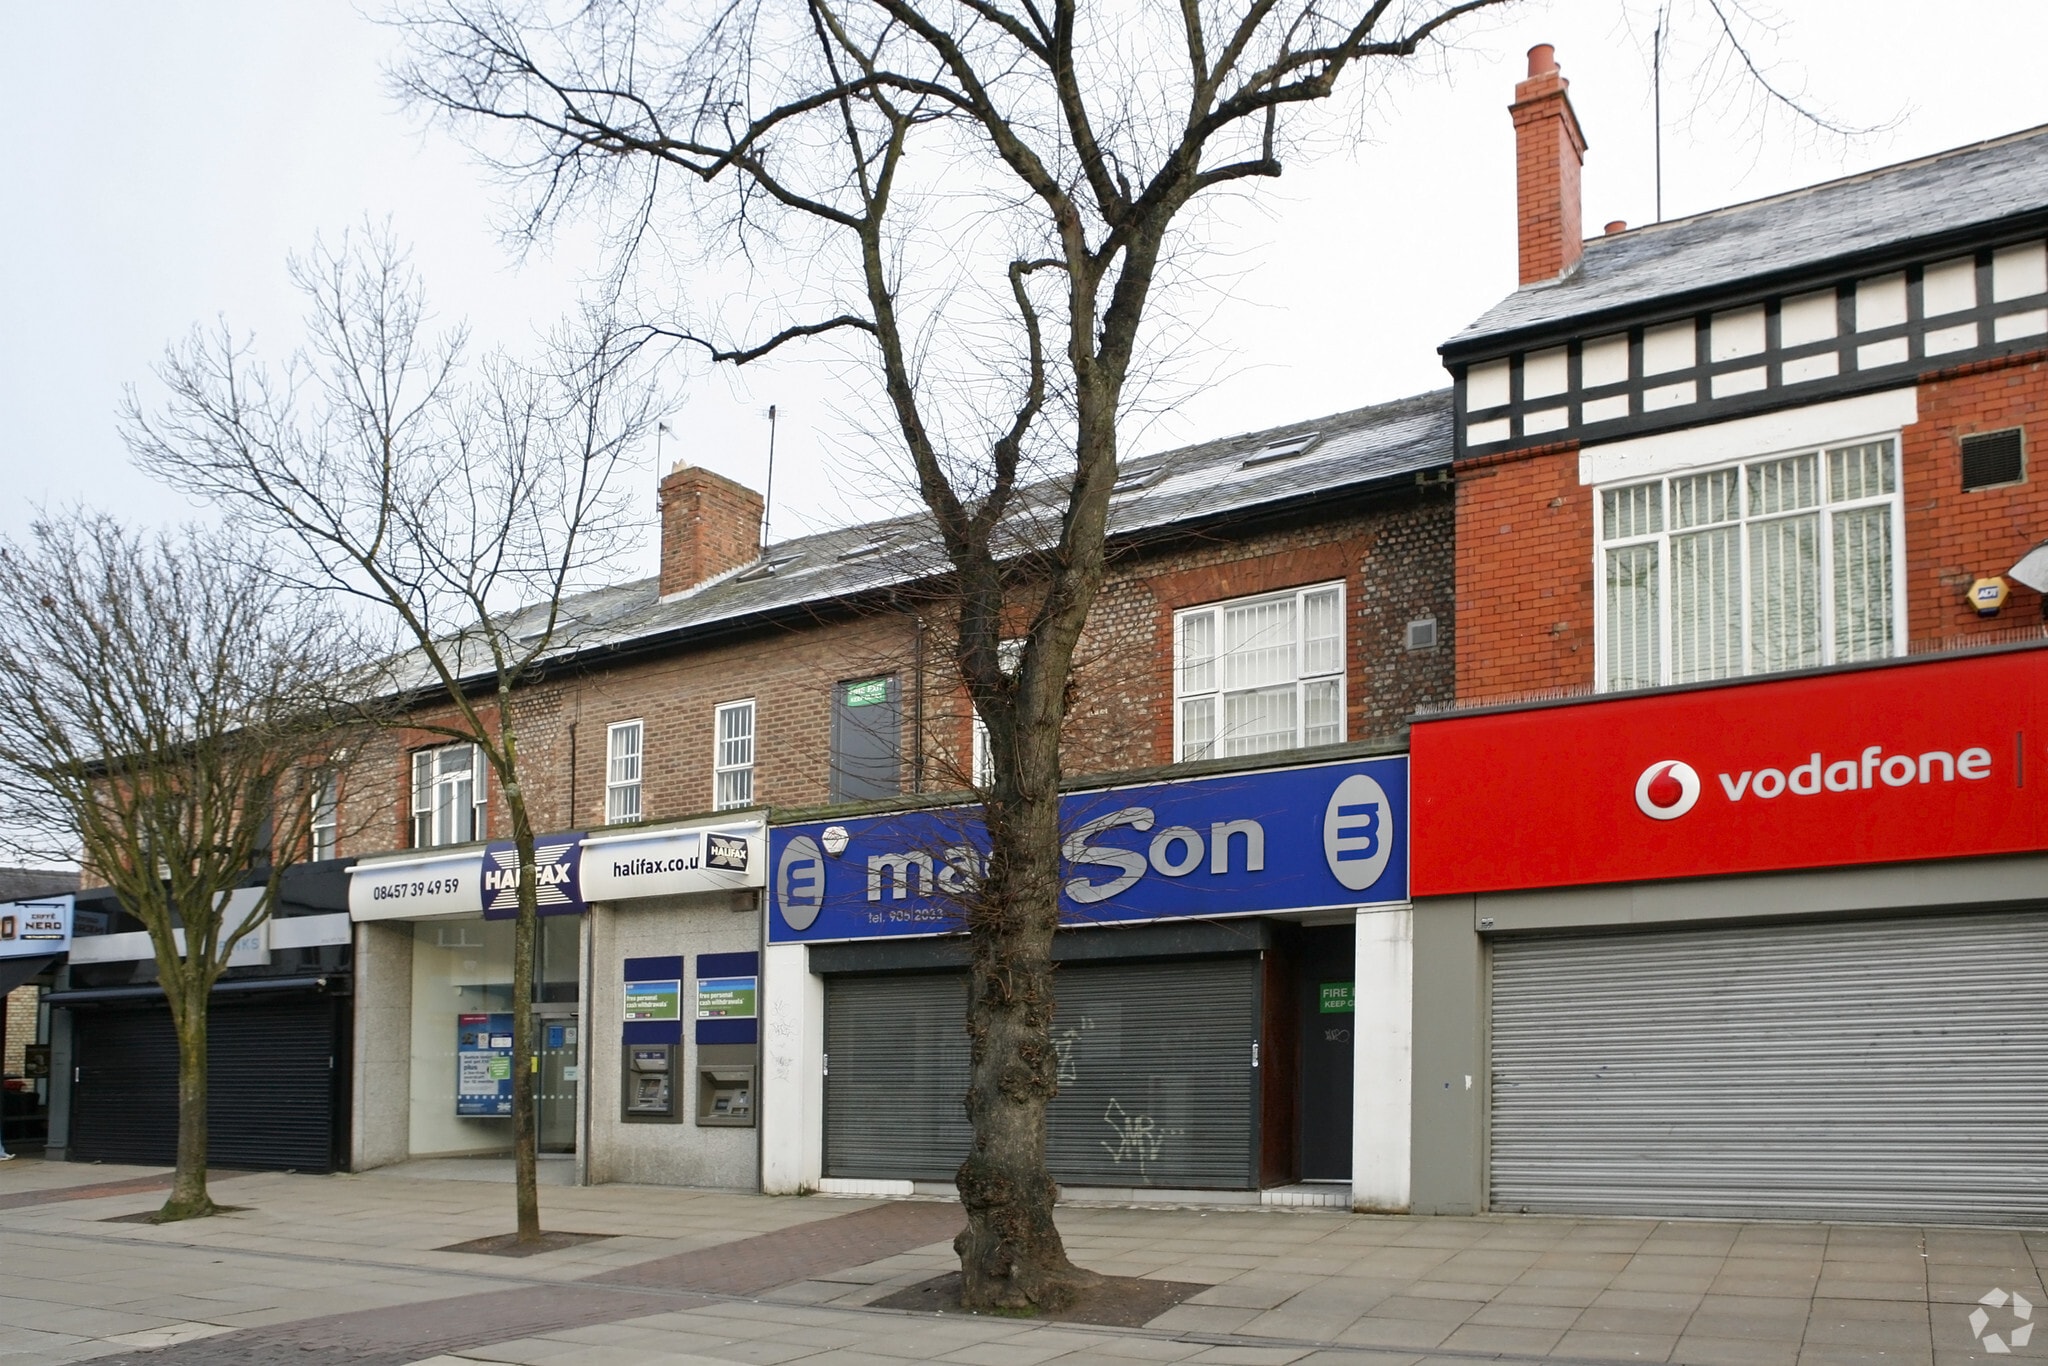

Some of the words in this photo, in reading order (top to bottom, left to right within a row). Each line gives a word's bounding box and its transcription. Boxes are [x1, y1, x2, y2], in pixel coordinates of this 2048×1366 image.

[1979, 588, 1998, 599] ADT
[1718, 745, 1992, 802] vodafone
[711, 845, 747, 860] HALIFAX
[613, 856, 699, 877] halifax.co.u
[373, 883, 408, 900] 08457
[411, 881, 425, 897] 39
[427, 880, 441, 895] 49
[444, 878, 459, 893] 59
[25, 921, 62, 930] NERO
[1323, 988, 1348, 998] FIRE
